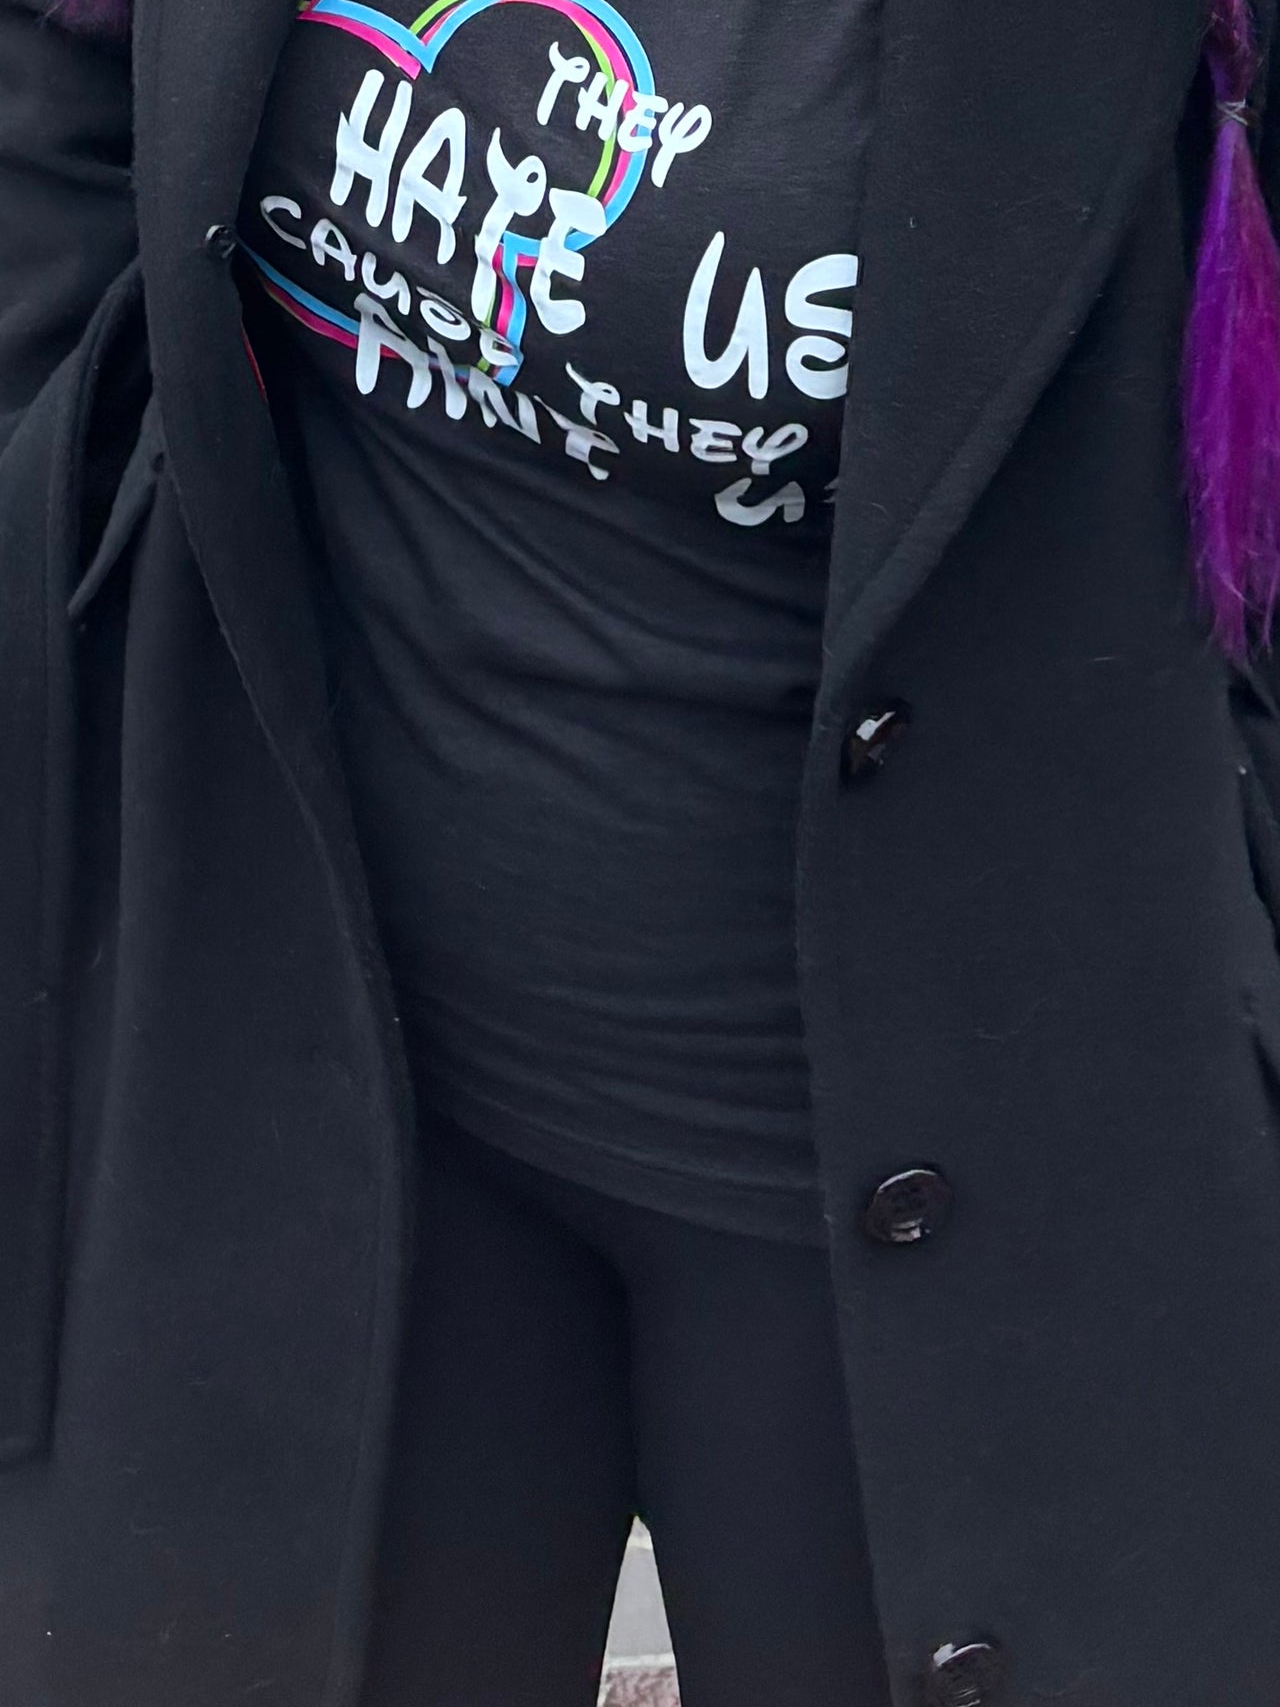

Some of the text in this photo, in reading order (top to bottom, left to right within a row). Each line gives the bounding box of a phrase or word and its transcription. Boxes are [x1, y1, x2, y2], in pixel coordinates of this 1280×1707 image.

[329, 67, 858, 400] HATE US
[535, 40, 712, 188] THEY
[260, 194, 809, 476] CAUSE THEY
